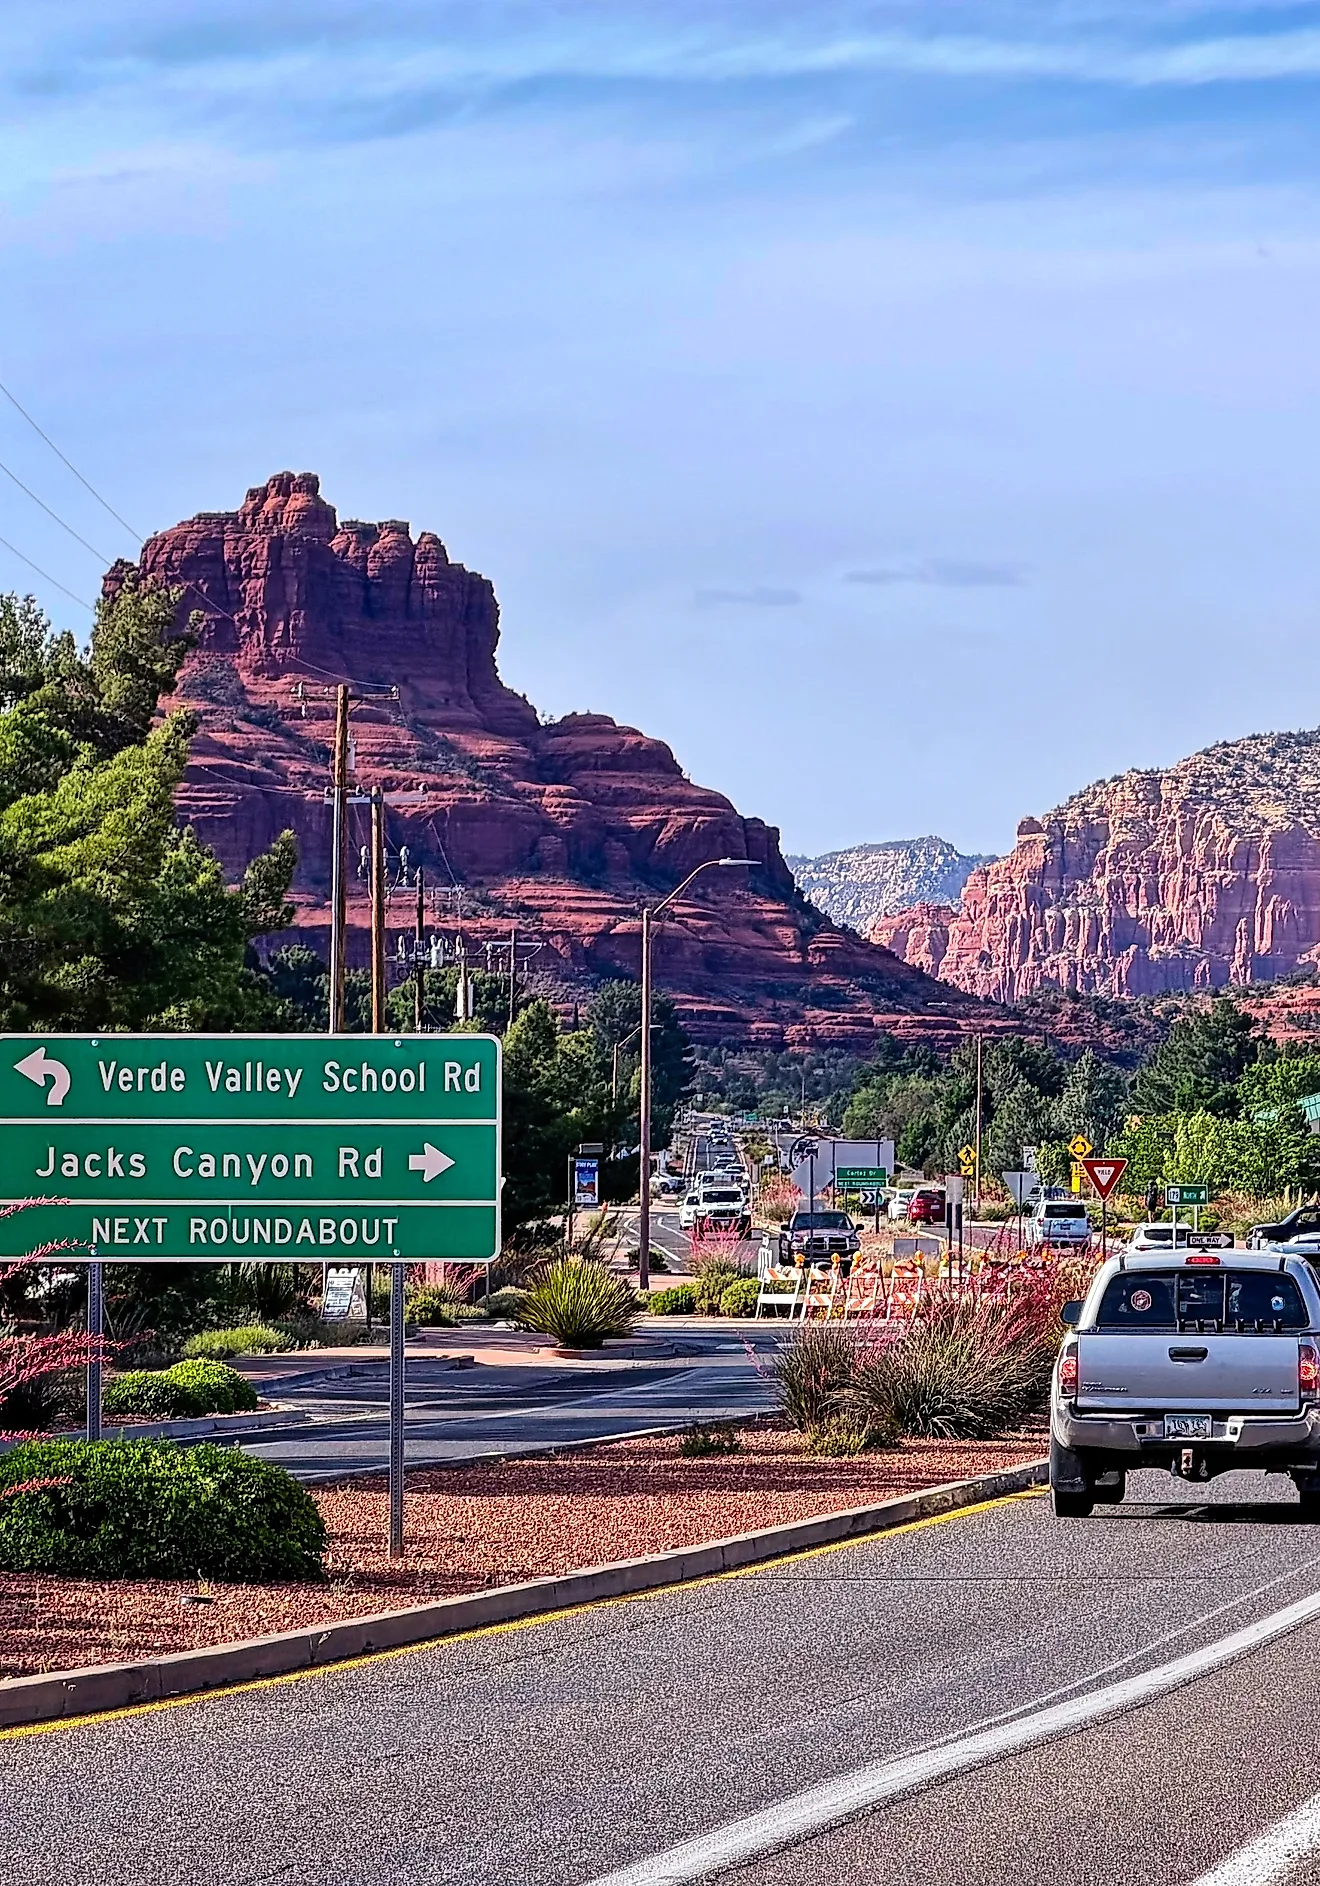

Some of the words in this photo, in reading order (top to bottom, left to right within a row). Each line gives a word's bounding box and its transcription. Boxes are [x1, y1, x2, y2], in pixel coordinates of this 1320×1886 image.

[98, 1060, 186, 1092] Verde
[205, 1060, 303, 1098] Valley
[322, 1060, 425, 1092] School
[443, 1060, 481, 1092] Rd
[35, 1146, 147, 1178] Jacks
[172, 1145, 313, 1186] Canyon
[338, 1146, 383, 1178] Rd
[92, 1217, 169, 1244] NEXT
[189, 1217, 399, 1245] ROUNDABOUT
